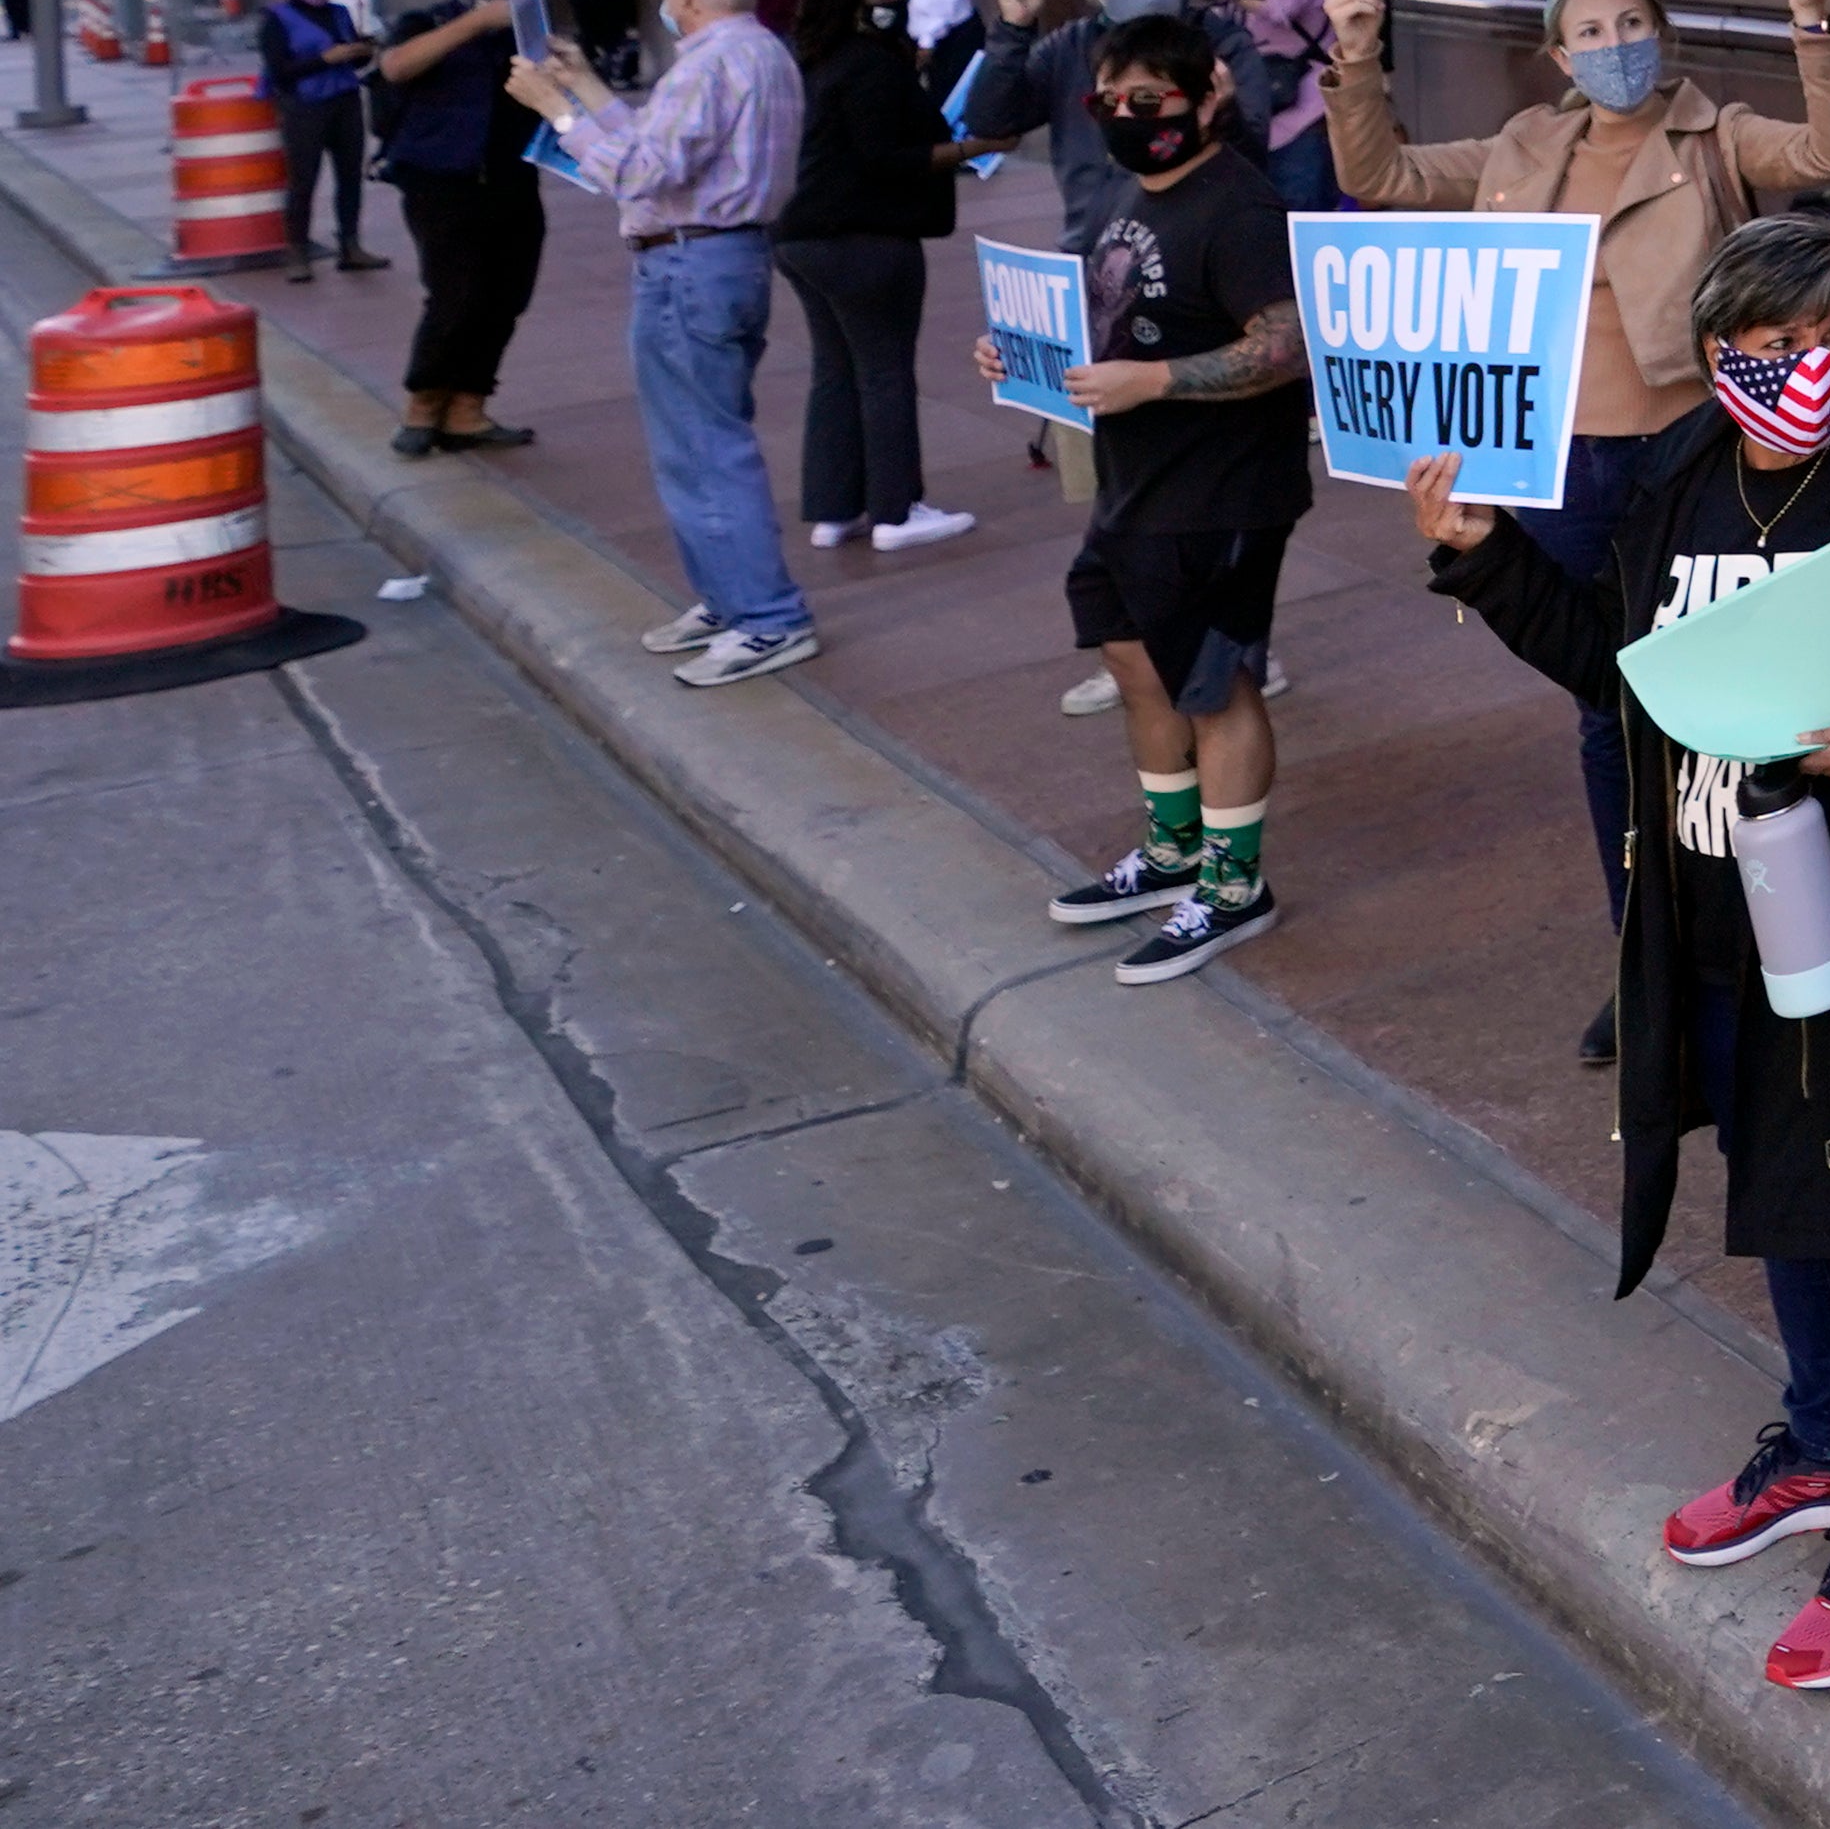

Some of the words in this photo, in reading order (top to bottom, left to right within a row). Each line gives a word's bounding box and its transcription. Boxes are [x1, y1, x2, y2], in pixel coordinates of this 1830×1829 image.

[983, 259, 1070, 343] COUNT
[1313, 244, 1561, 354] COUNT
[1324, 354, 1421, 445] EVERY
[1432, 362, 1541, 451] VOTE
